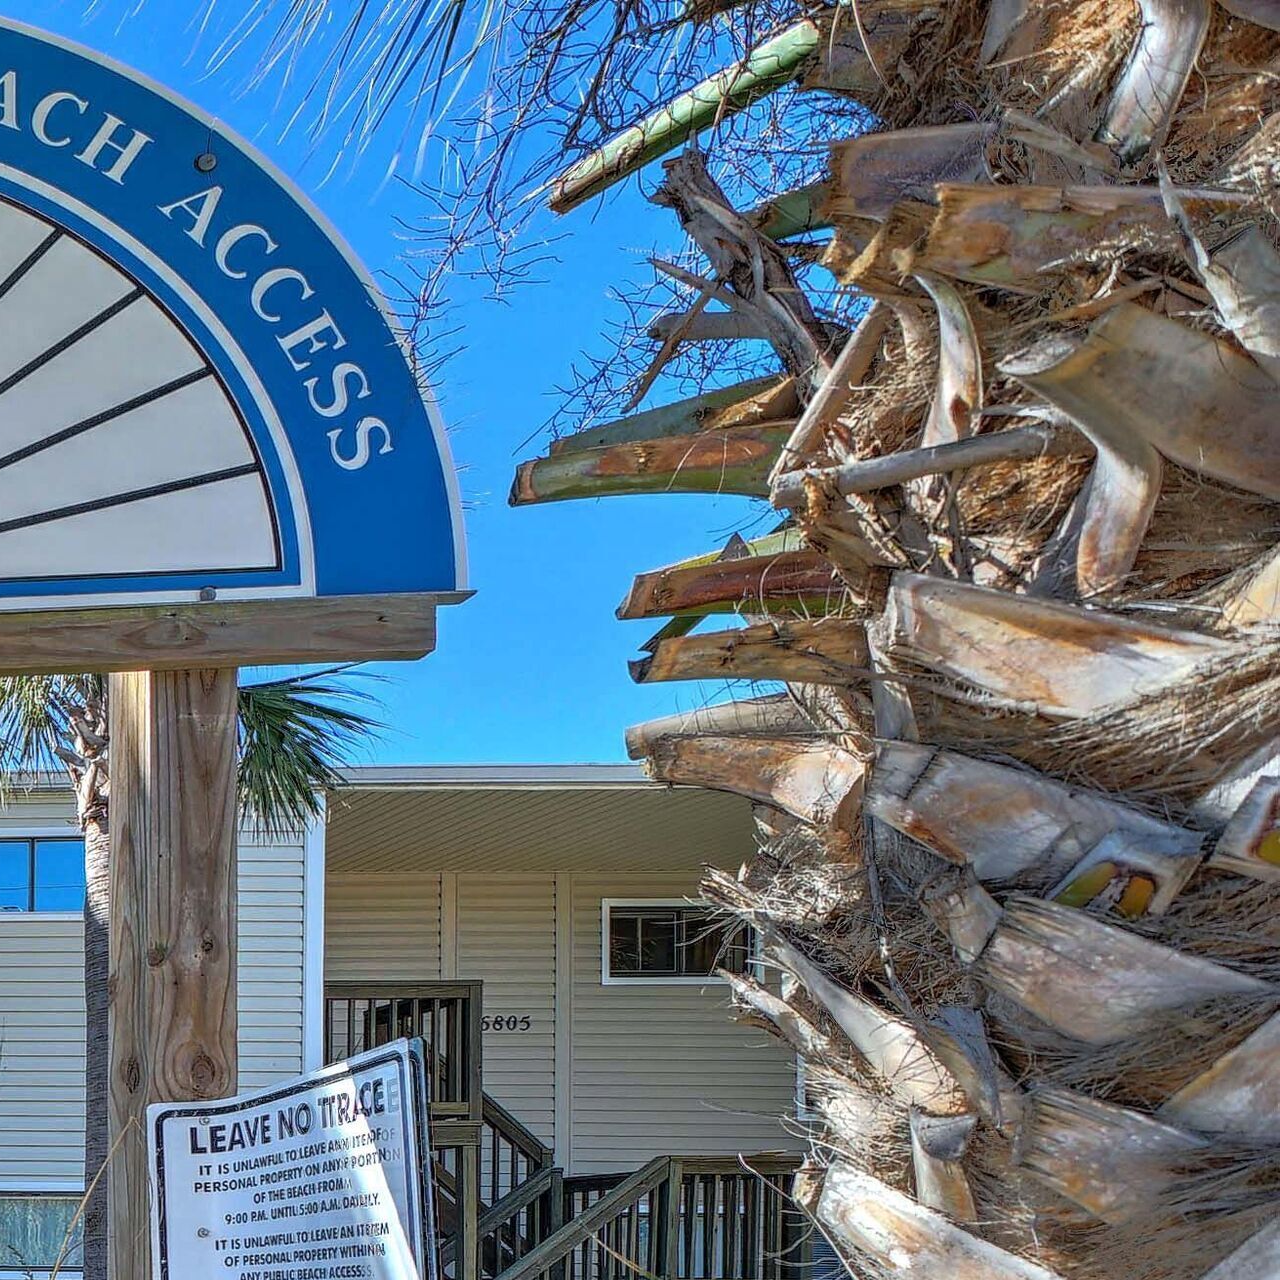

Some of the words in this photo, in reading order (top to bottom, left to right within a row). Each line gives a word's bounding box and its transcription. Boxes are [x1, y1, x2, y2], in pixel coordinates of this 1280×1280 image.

[156, 184, 394, 470] ACCESS
[189, 1113, 272, 1155] LEAVE
[277, 1102, 313, 1140] NO
[317, 1077, 390, 1130] TRACE
[199, 1164, 213, 1177] IT
[217, 1161, 231, 1175] IS
[232, 1151, 284, 1174] UNLAWFUL
[285, 1147, 297, 1162] TO
[298, 1141, 327, 1160] LEAVE
[194, 1170, 258, 1194] PERSONAL
[260, 1166, 304, 1186] PROPERTY
[304, 1162, 321, 1177] ON
[322, 1156, 343, 1174] ANY
[253, 1191, 266, 1204] OF
[268, 1188, 286, 1202] THE
[287, 1183, 316, 1200] BEACH
[317, 1180, 346, 1194] FROM
[225, 1213, 248, 1226] 9:00
[270, 1206, 297, 1221] UNTIL
[298, 1202, 319, 1217] 5:00
[215, 1239, 227, 1251] IT
[230, 1238, 241, 1250] IS
[243, 1233, 295, 1250] UNLAWFUL
[296, 1230, 309, 1244] TO
[310, 1227, 338, 1243] LEAVE
[339, 1225, 355, 1239] AN
[224, 1255, 240, 1268] OF
[243, 1250, 291, 1267] PERSONAL
[293, 1247, 338, 1264] PROPERTY
[339, 1242, 384, 1259] WITHIN
[297, 1266, 326, 1280] BEACH
